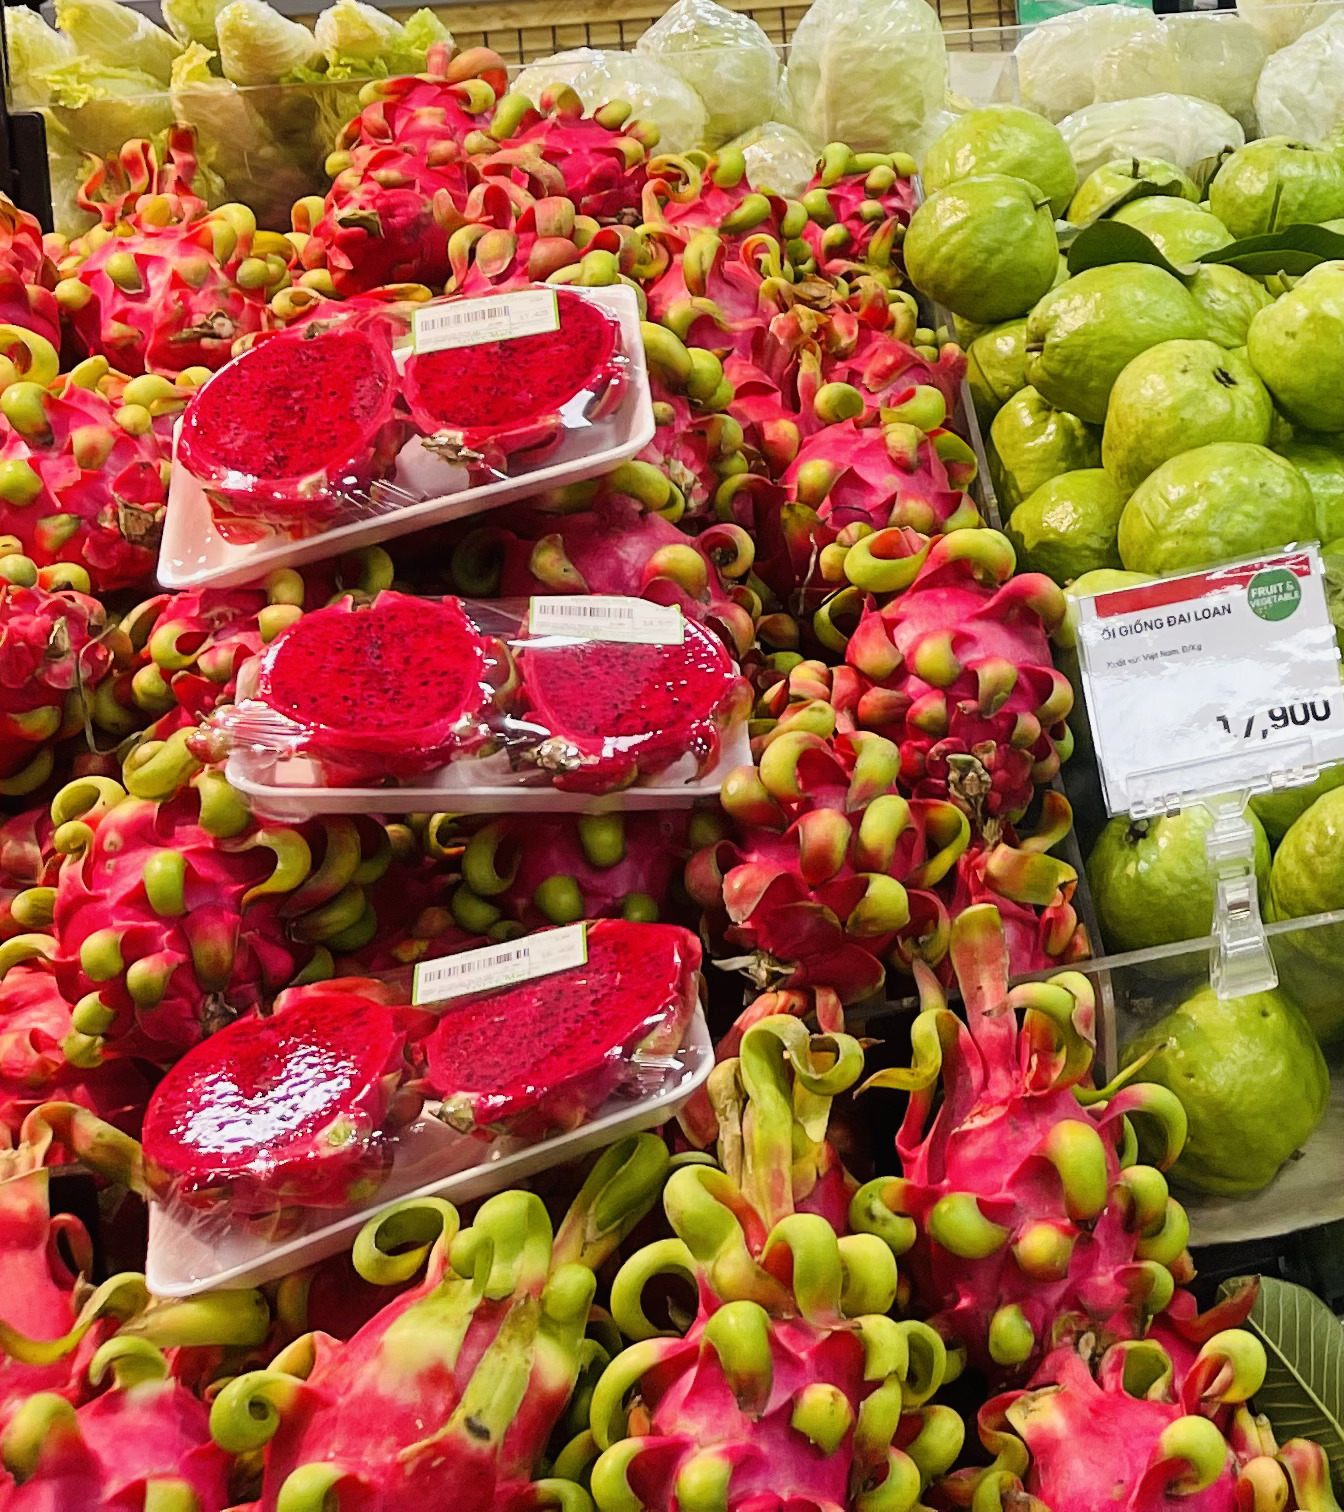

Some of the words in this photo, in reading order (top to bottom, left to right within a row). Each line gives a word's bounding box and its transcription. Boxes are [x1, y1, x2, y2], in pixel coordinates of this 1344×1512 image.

[1251, 581, 1284, 598] FRUIT
[1119, 617, 1165, 638] GIỐNG
[1194, 603, 1233, 623] LOAN
